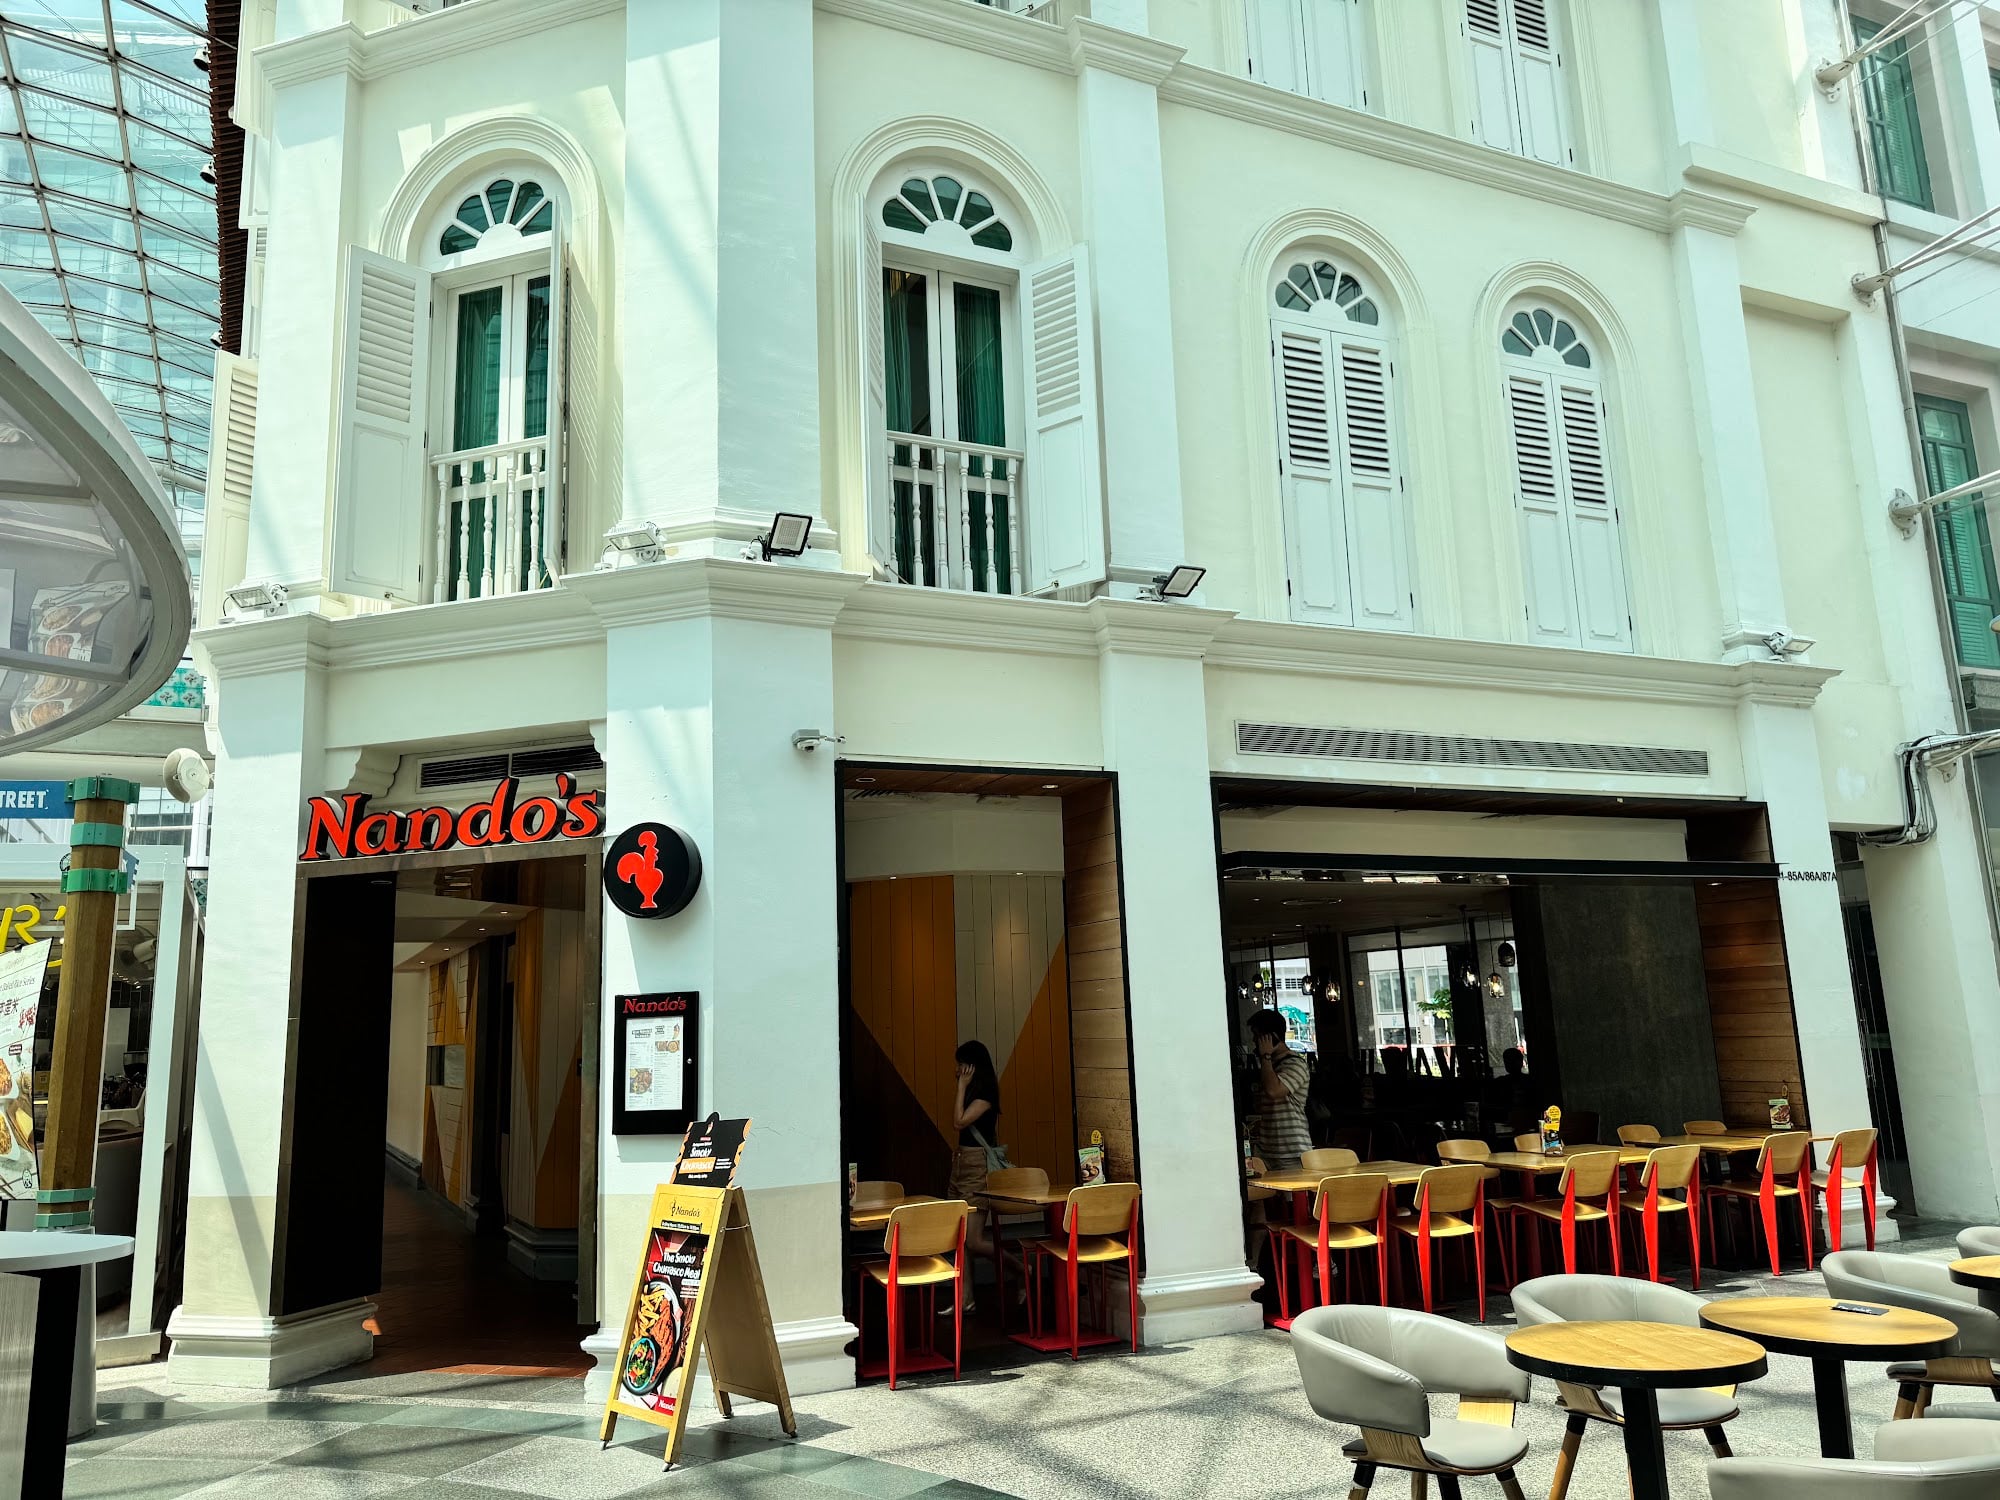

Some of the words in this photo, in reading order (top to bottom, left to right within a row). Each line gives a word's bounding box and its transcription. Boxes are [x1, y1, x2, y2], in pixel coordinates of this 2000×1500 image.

[300, 772, 606, 861] Nando's
[623, 996, 687, 1014] Nando's
[676, 1206, 701, 1217] Nando's
[664, 1252, 675, 1262] The
[675, 1253, 696, 1264] Smoky
[653, 1262, 684, 1277] Churrasco
[684, 1267, 700, 1279] Meal
